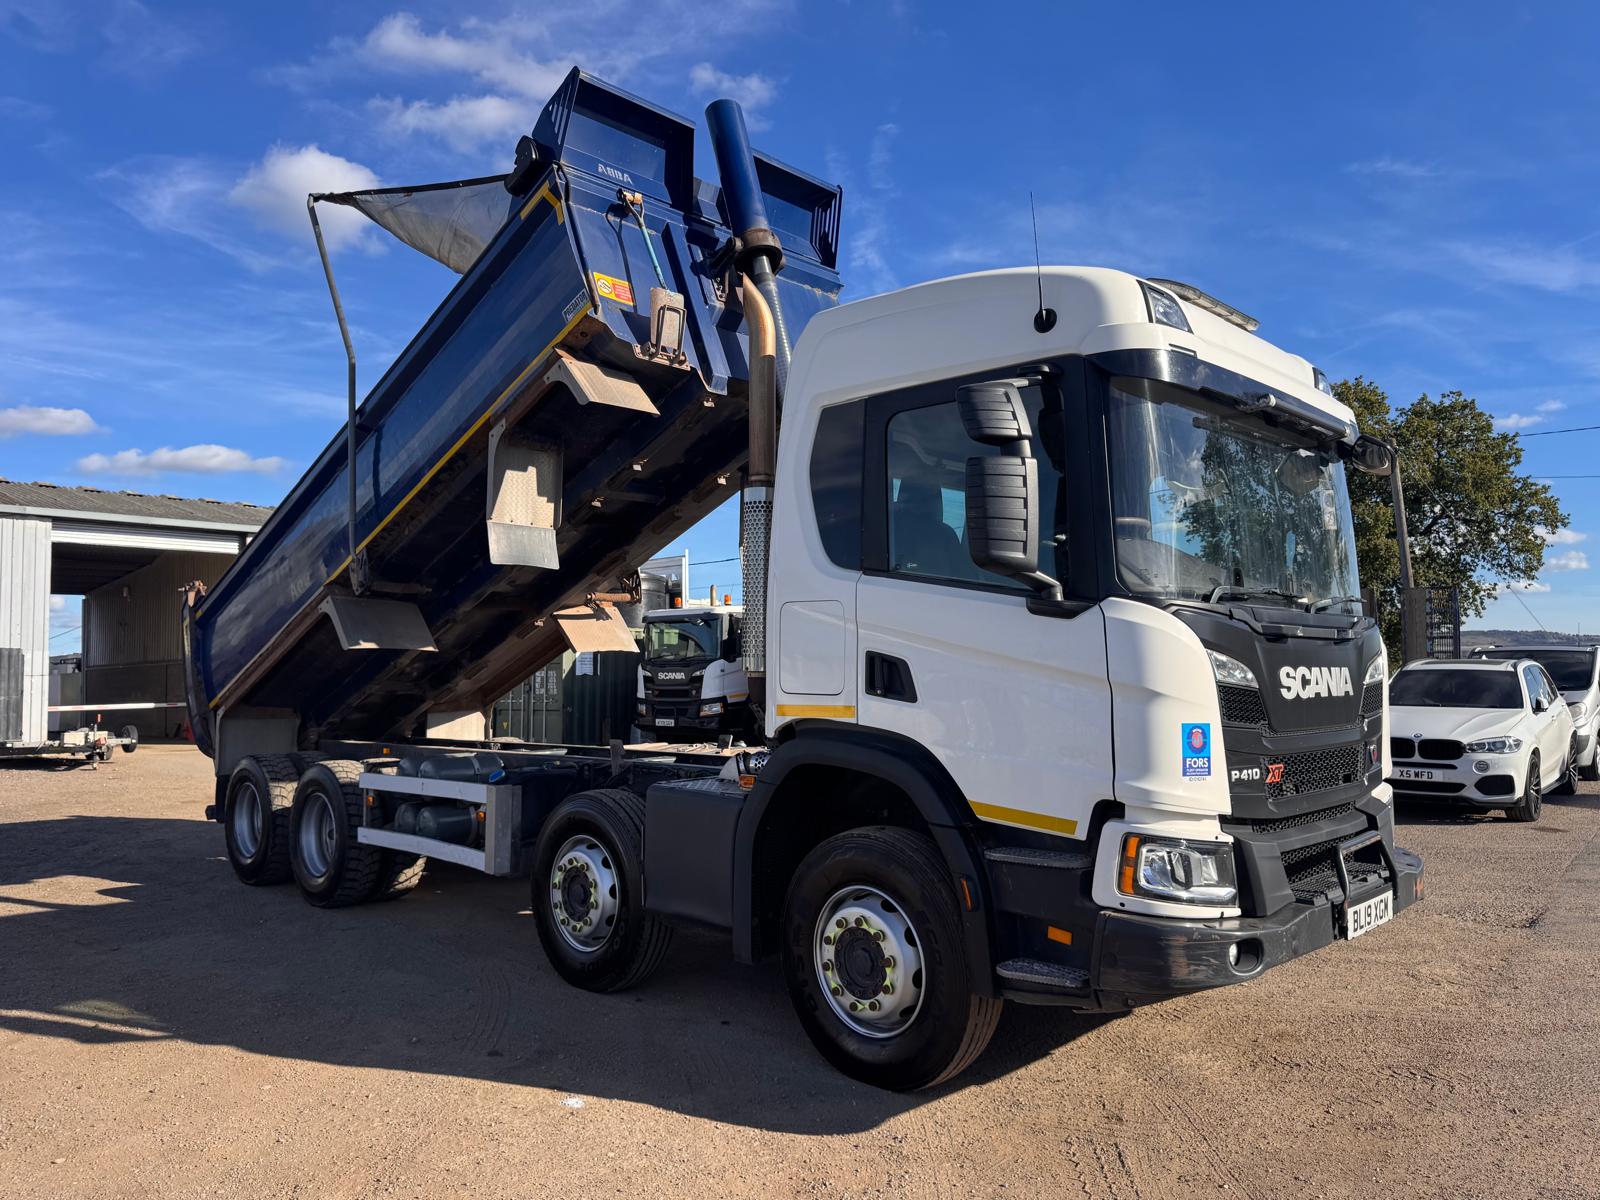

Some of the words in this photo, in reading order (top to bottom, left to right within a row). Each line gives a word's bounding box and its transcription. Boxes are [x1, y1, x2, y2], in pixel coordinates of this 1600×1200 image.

[658, 672, 686, 680] SCANIA
[1279, 665, 1354, 700] SCANIA
[1186, 757, 1209, 768] FORS
[1399, 769, 1411, 778] X5
[1413, 770, 1433, 780] WFD
[1353, 903, 1372, 933] BL19
[1374, 895, 1389, 923] XGM
